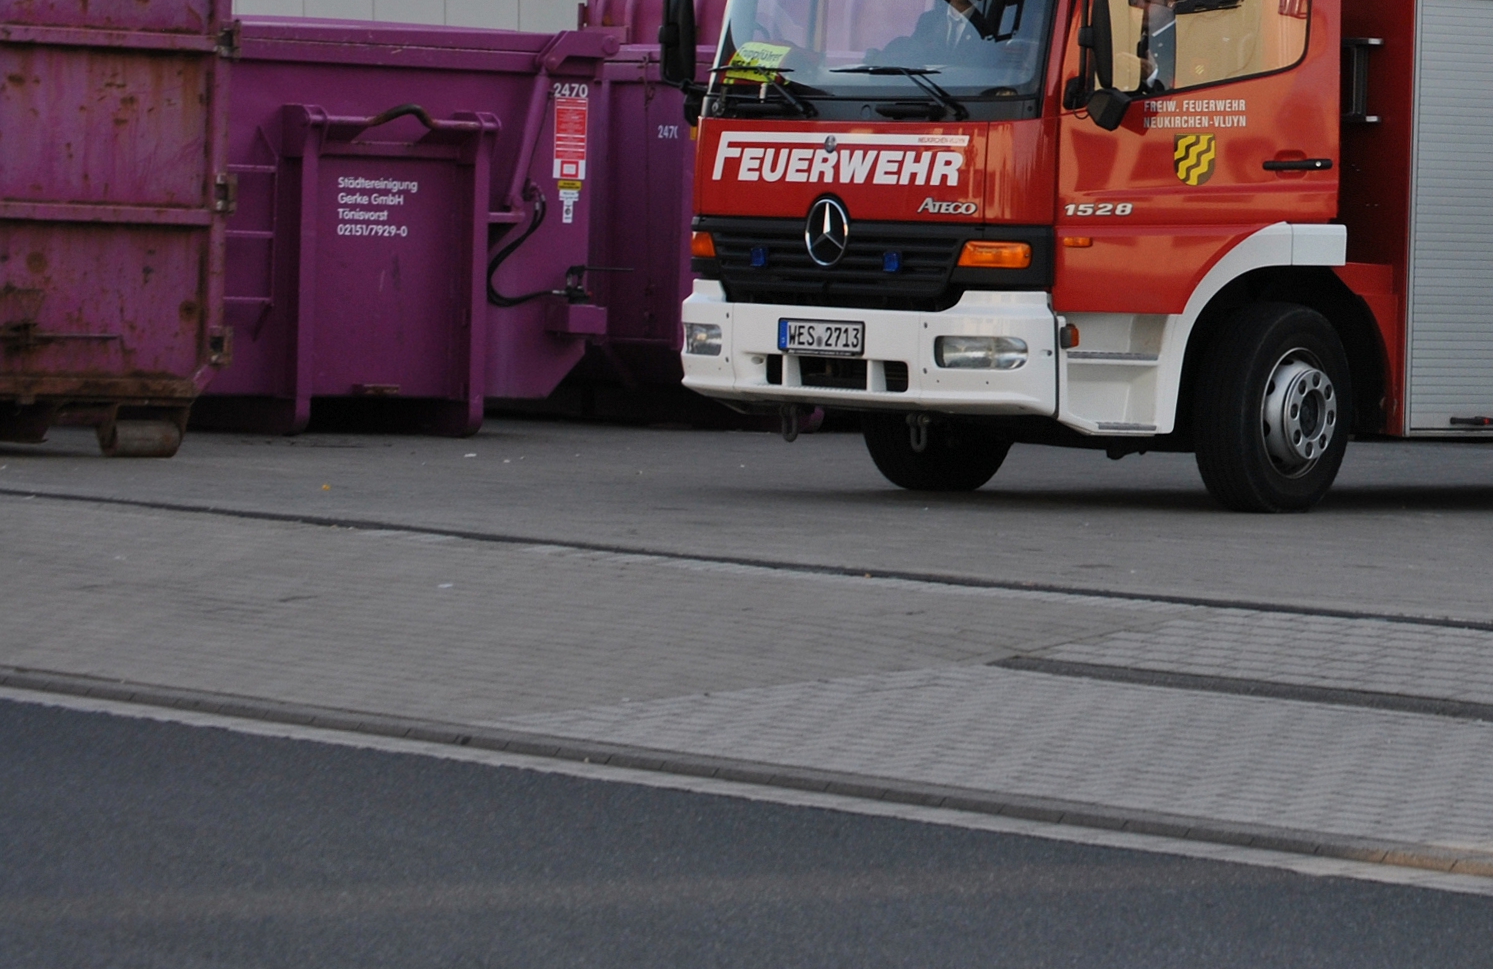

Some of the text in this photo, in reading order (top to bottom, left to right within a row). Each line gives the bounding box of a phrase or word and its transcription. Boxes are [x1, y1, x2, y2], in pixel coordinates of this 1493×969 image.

[553, 82, 588, 98] 2470
[1144, 99, 1246, 112] FREIW. FEUERWEHR
[1143, 115, 1247, 128] NEUKIRCHEN-VLUYN
[712, 131, 969, 186] FEUERWEHR
[338, 177, 418, 193] Städtereinigung
[337, 193, 404, 205] Gerke GmbH
[337, 209, 388, 220] Tönisvorst
[1064, 202, 1133, 216] 1528
[337, 224, 408, 237] 02151/7929-0
[789, 325, 859, 348] WES 2713
